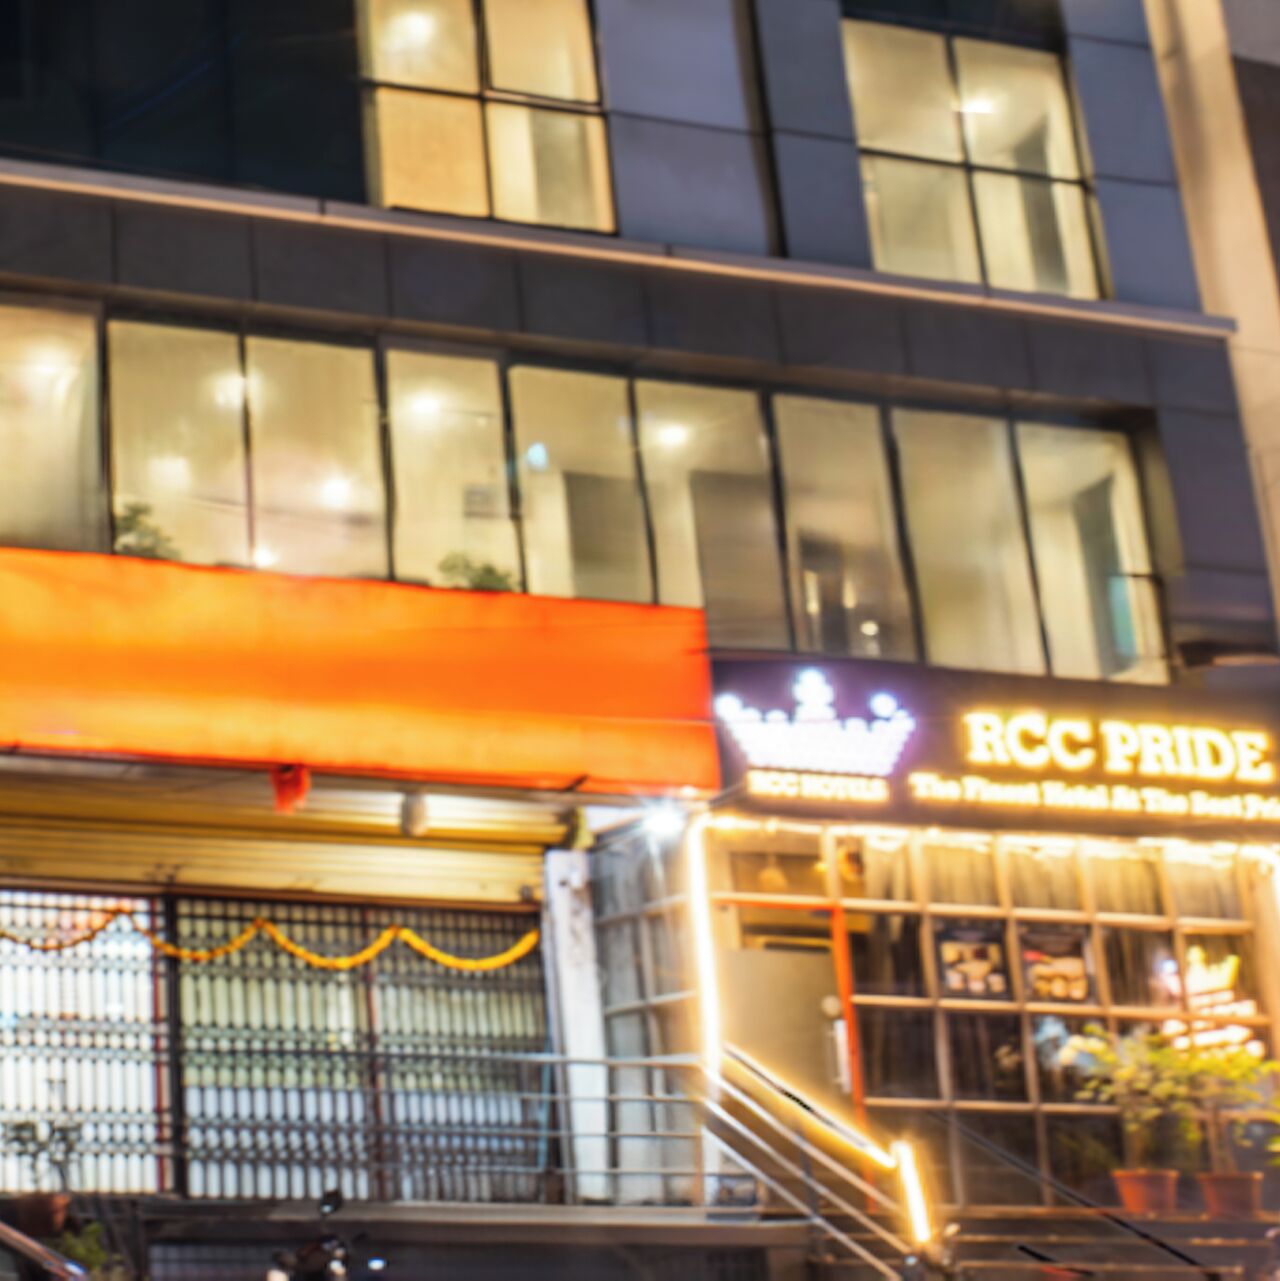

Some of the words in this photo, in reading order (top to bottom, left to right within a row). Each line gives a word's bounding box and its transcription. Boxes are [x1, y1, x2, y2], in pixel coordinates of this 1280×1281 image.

[963, 711, 1097, 770] RCC
[1099, 719, 1277, 783] PRIDE
[909, 772, 961, 799] The
[962, 776, 1039, 805] Finest
[1042, 781, 1108, 809] Hotel
[1141, 787, 1188, 814] The
[1190, 791, 1243, 817] Best
